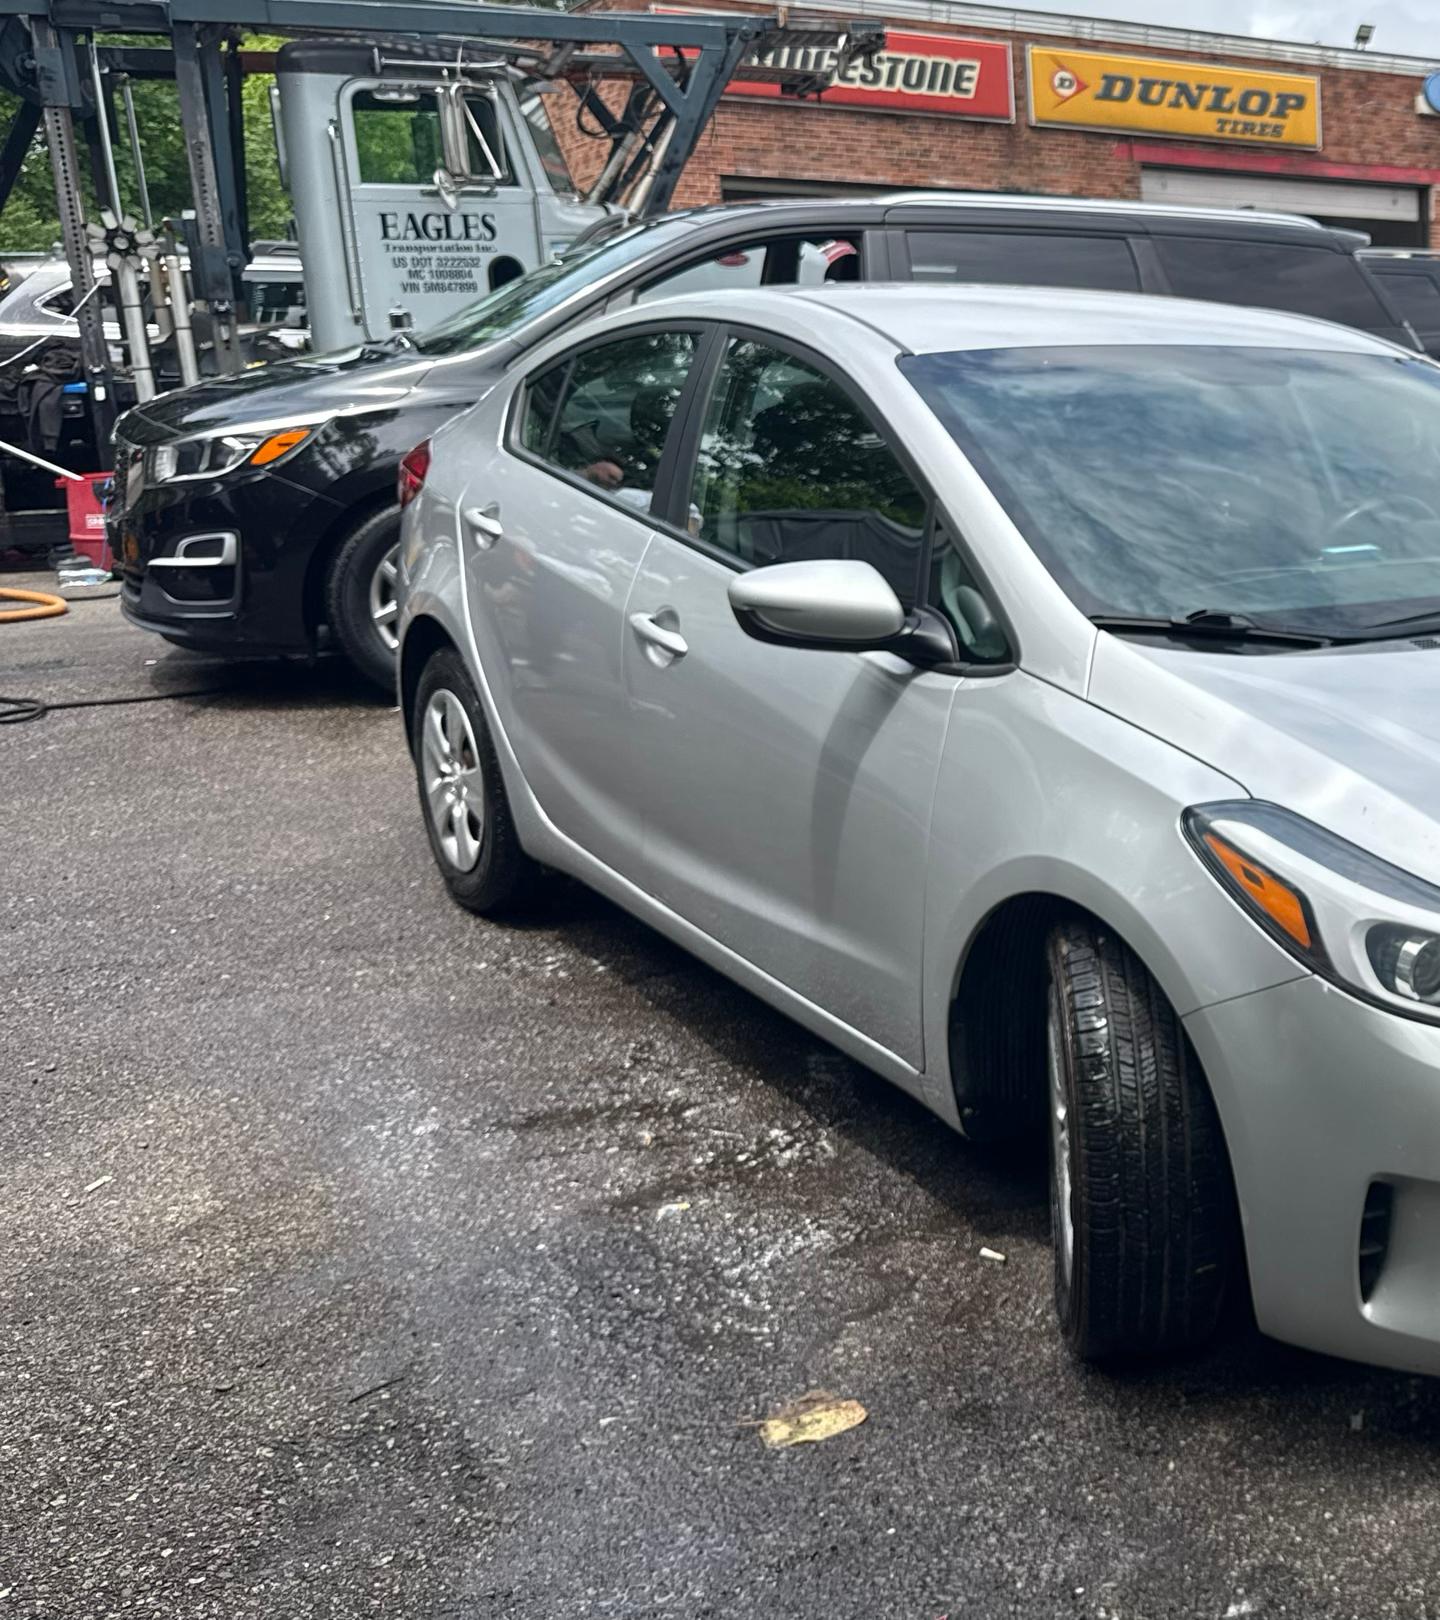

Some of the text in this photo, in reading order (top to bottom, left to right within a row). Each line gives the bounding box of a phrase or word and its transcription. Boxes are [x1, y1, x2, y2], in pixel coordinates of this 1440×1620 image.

[748, 46, 980, 98] IDGESTONE
[1094, 73, 1307, 120] DUNLOP
[1215, 117, 1286, 138] TIRES
[377, 211, 498, 241] EAGLES
[384, 243, 473, 254] Transportation
[392, 256, 408, 268] US
[411, 256, 433, 268] DOT
[408, 269, 426, 280] MC
[401, 281, 420, 293] VIN
